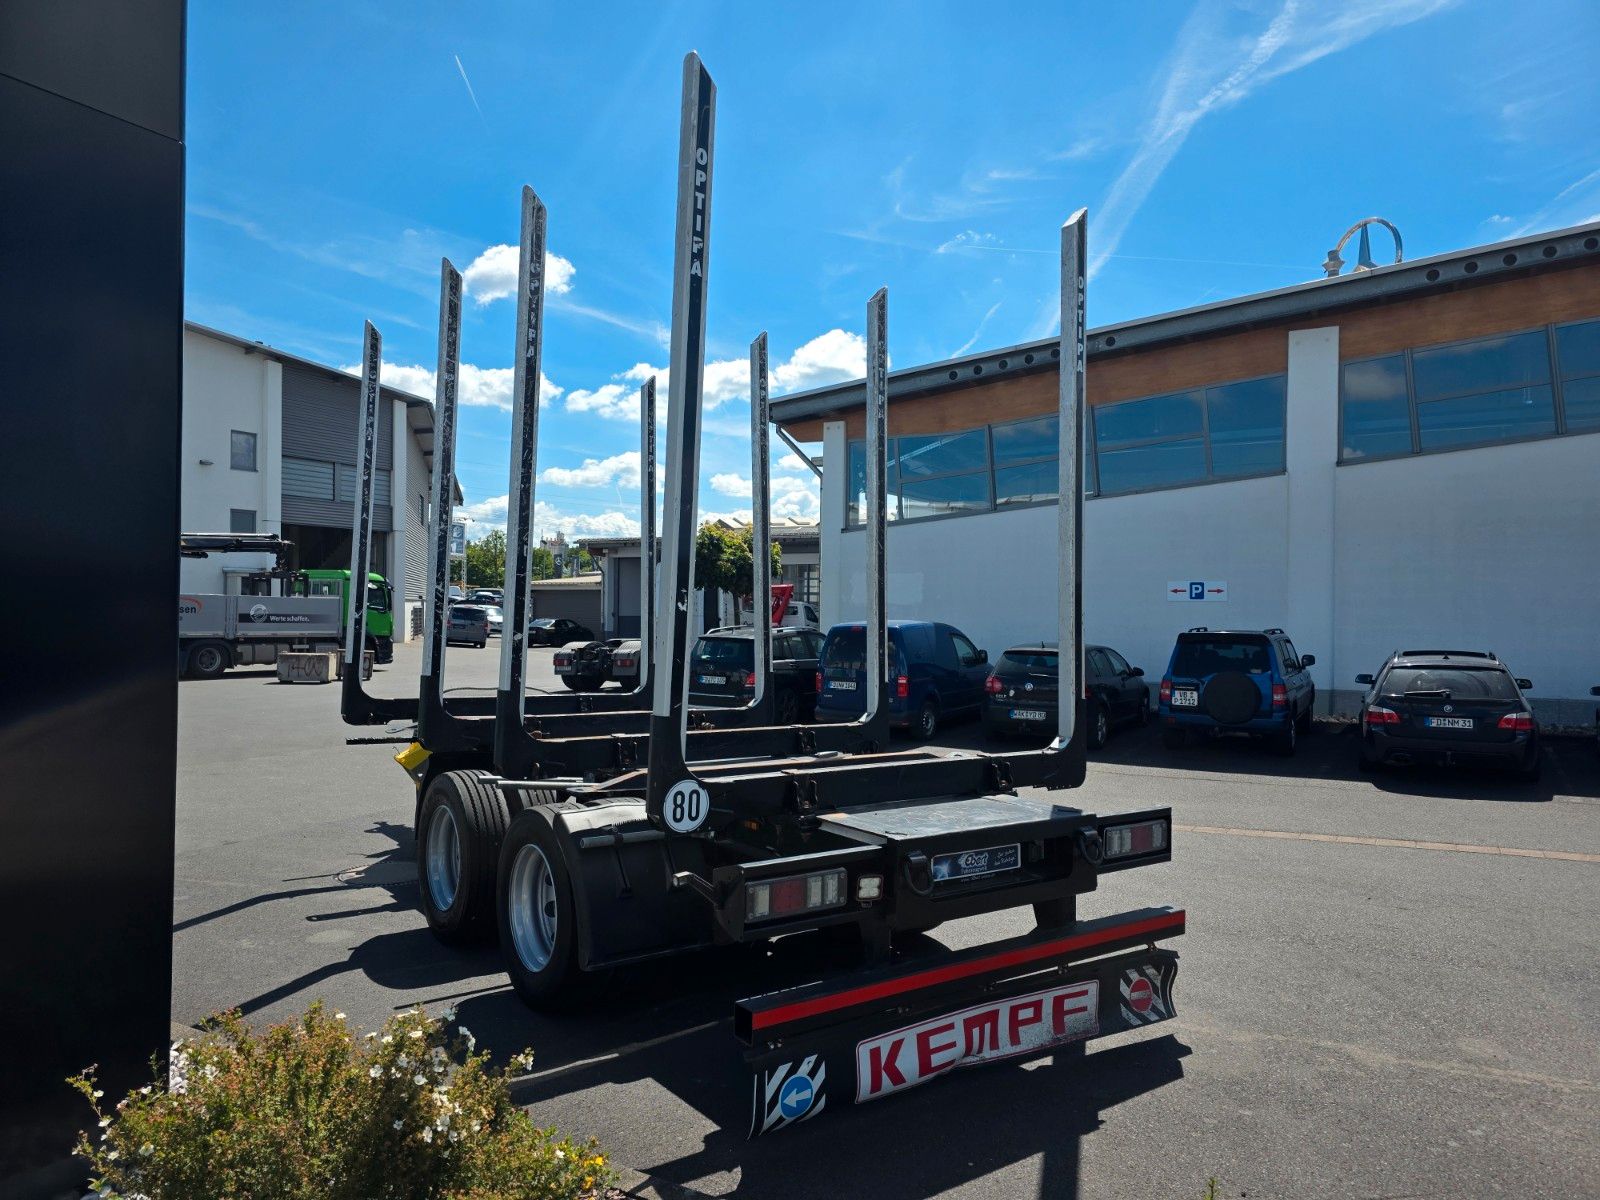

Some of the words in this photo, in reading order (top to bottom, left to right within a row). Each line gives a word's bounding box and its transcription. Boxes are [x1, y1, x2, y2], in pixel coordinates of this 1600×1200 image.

[690, 147, 708, 277] OPTIPA
[1191, 584, 1203, 598] P
[673, 789, 700, 823] 80
[868, 989, 1089, 1095] KEMPF
